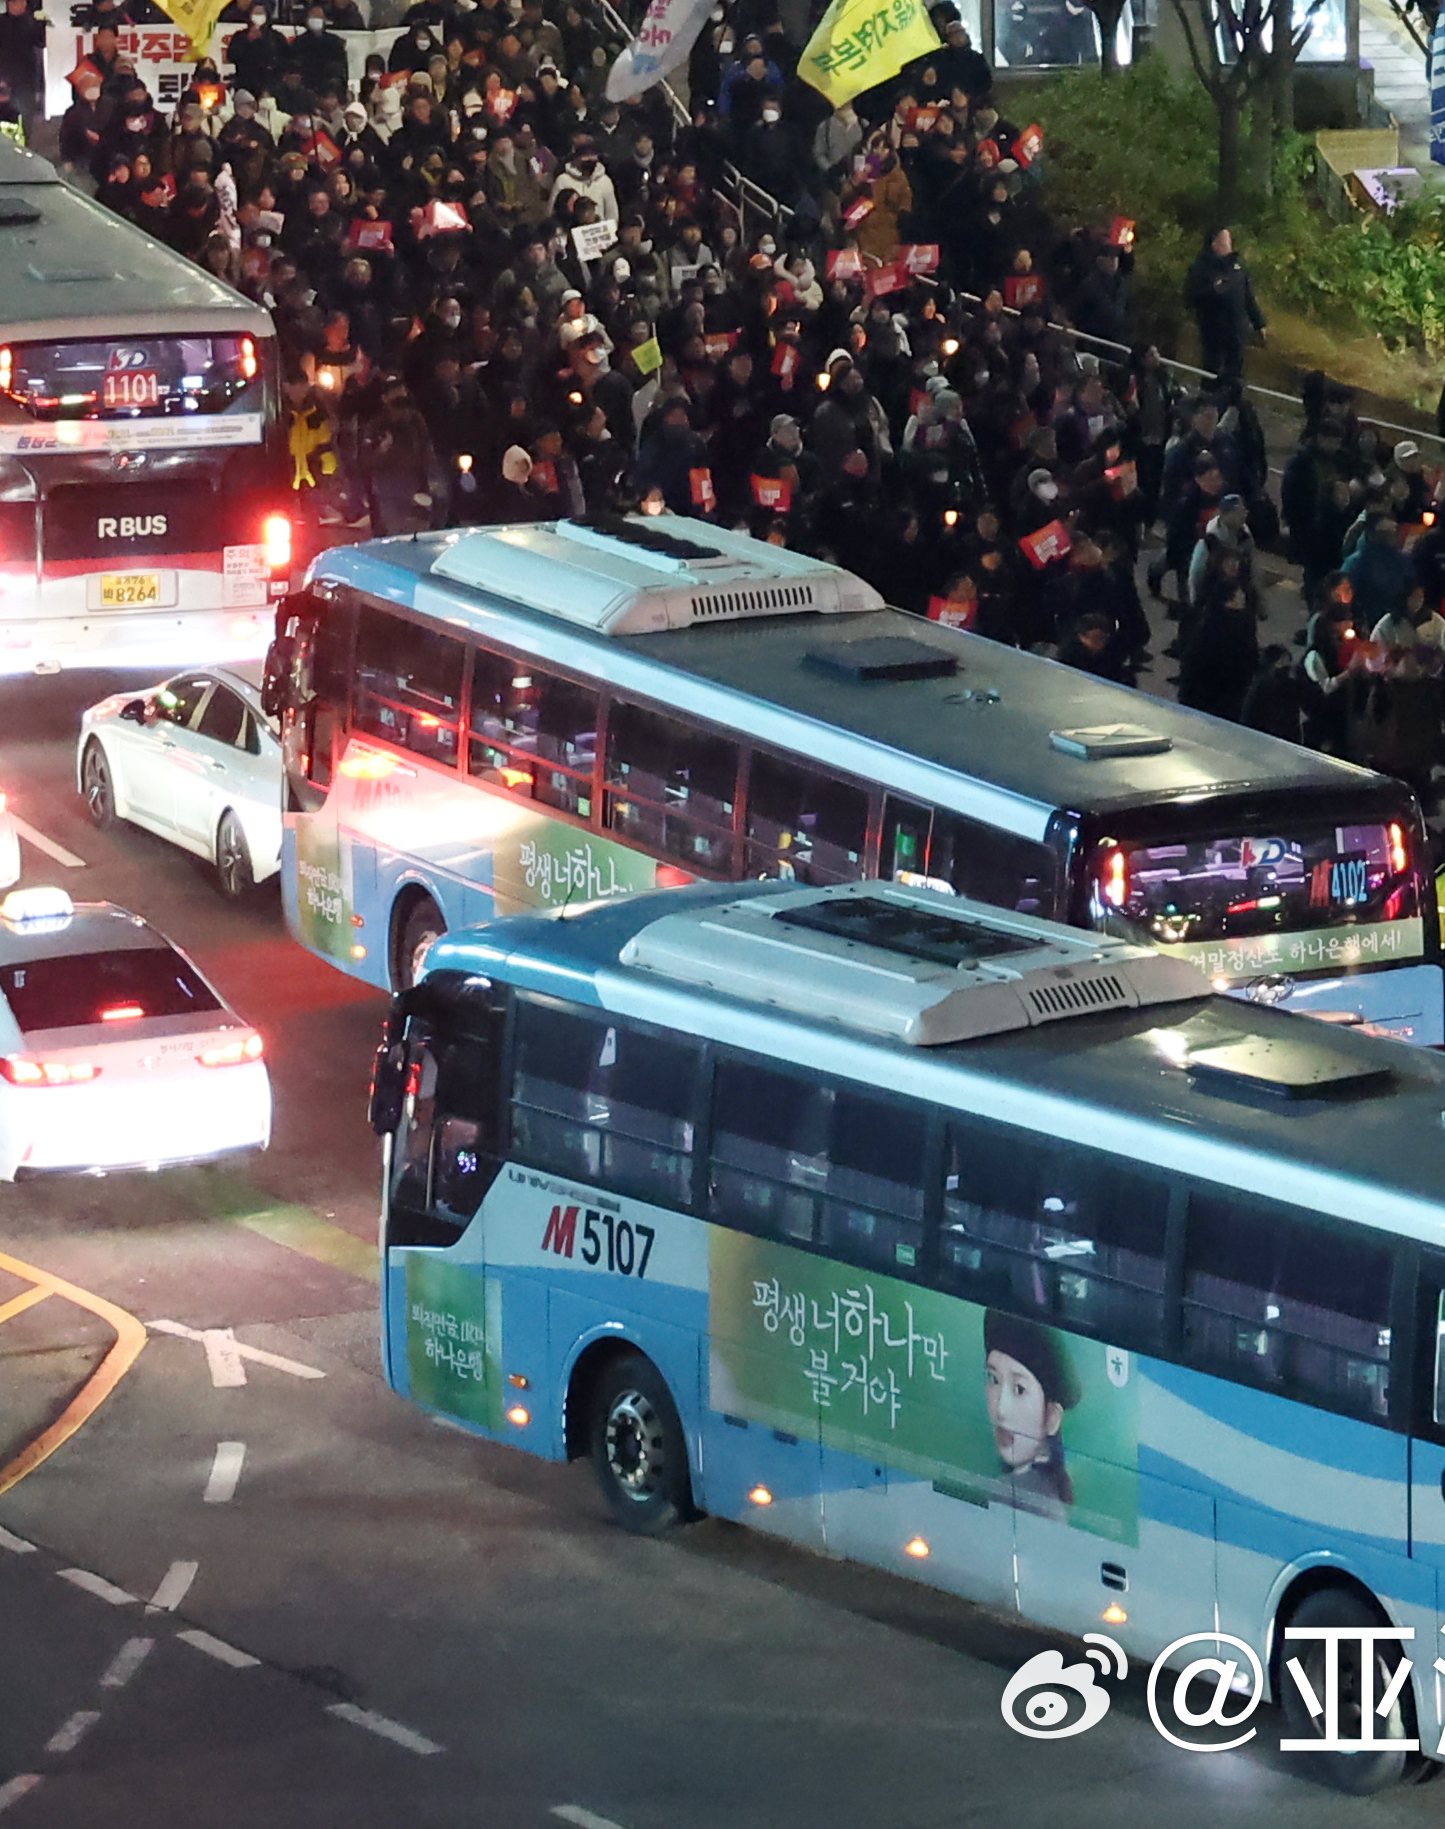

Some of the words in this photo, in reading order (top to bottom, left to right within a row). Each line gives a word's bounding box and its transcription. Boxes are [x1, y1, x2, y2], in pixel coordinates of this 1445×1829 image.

[106, 373, 158, 404] 1101
[519, 841, 552, 899] 평생
[752, 1279, 806, 1344] 평생
[424, 1337, 485, 1382] 하나은행
[804, 1349, 835, 1409] 볼
[840, 1357, 904, 1431] 거야
